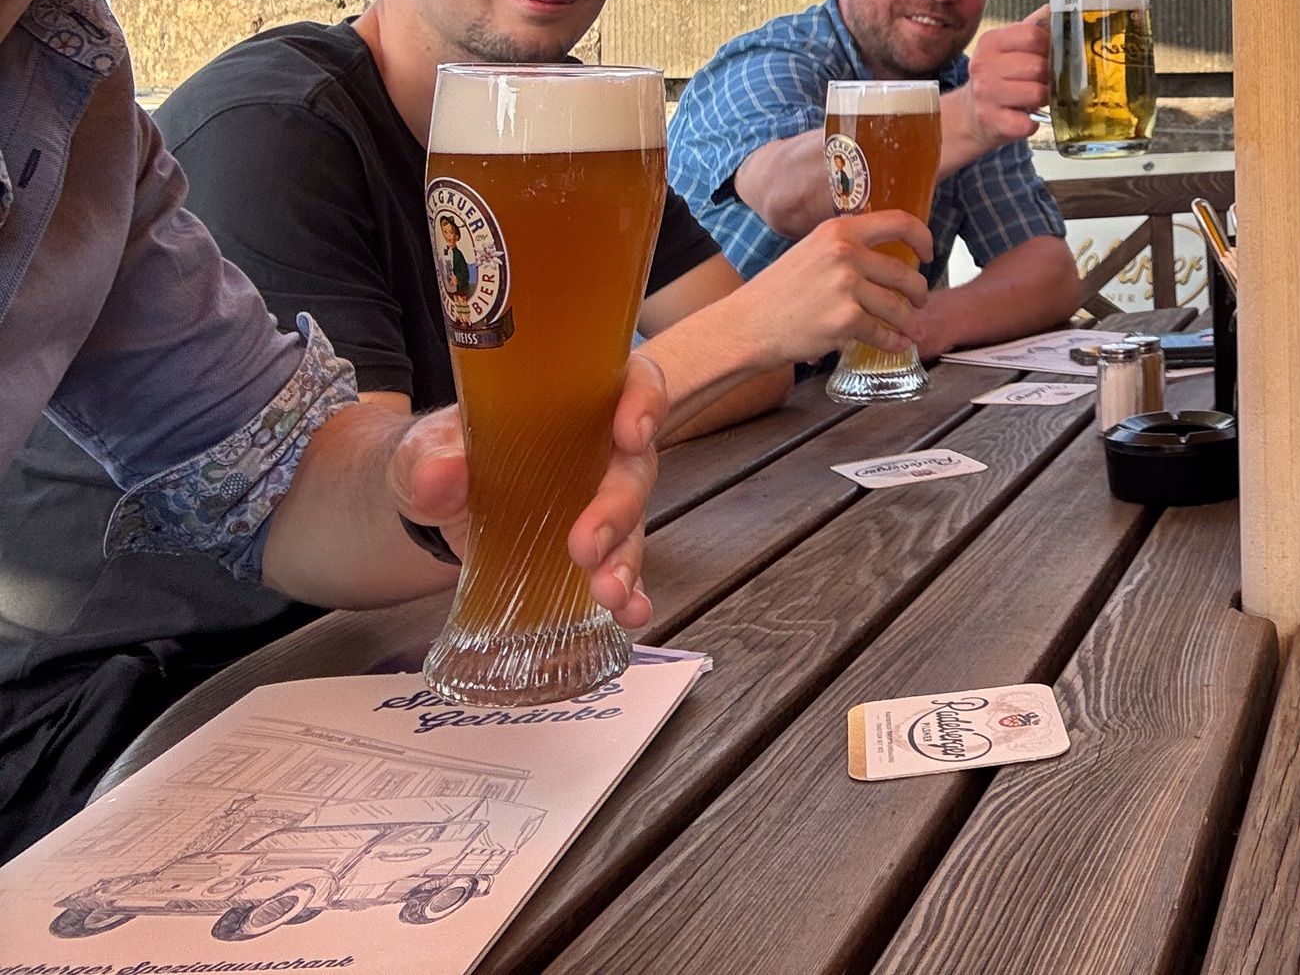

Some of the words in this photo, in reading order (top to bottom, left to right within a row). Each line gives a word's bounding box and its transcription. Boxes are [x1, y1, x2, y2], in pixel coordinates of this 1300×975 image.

[471, 273, 496, 316] BIER
[413, 706, 623, 734] Getränke
[920, 696, 990, 760] Radeberger
[0, 963, 113, 975] deberger
[116, 955, 356, 975] Spezialausschank
